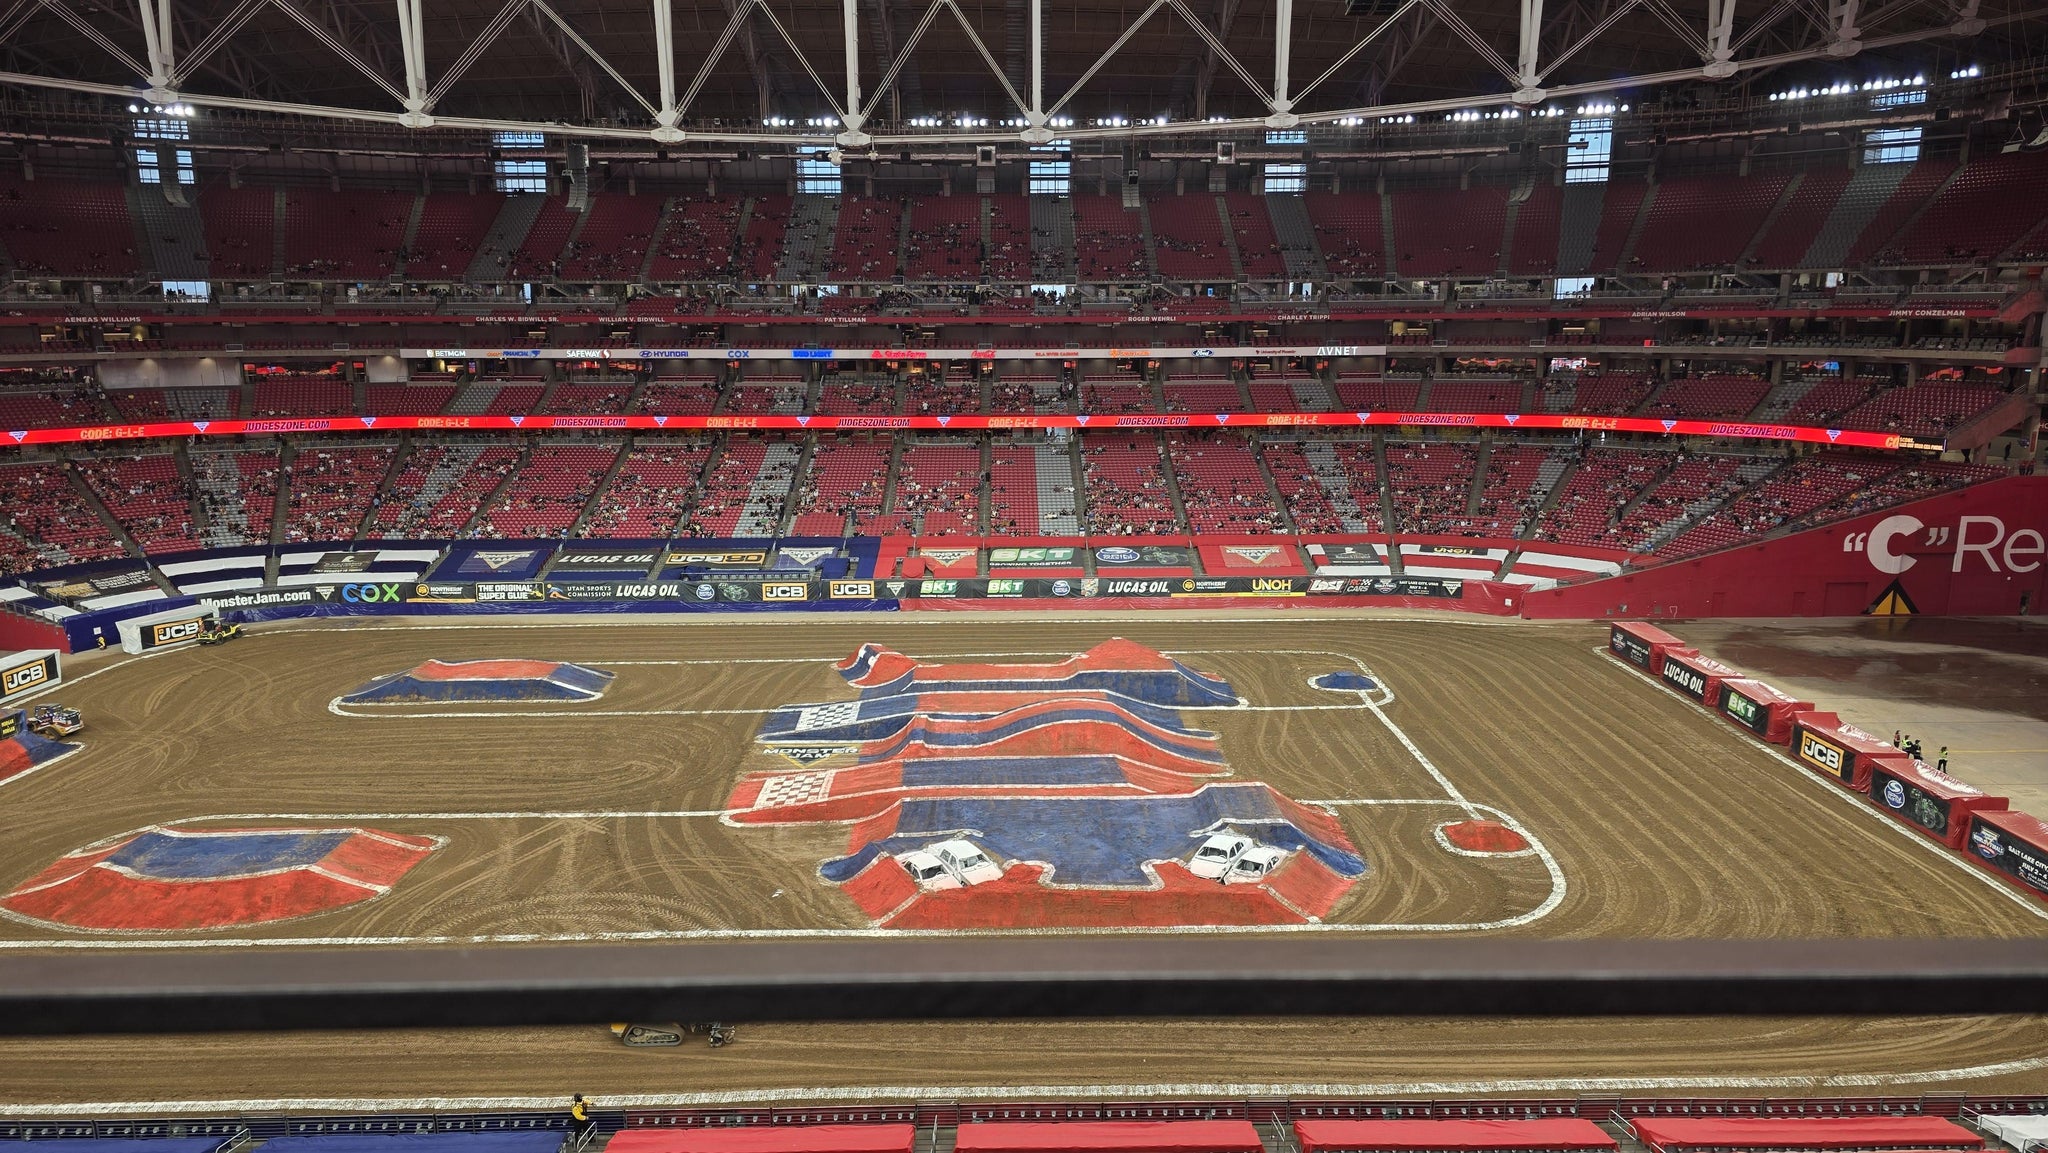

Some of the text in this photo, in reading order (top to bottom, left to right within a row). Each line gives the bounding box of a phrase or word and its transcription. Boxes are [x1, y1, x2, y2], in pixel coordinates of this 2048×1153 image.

[566, 350, 600, 358] SAFEWAY
[653, 350, 689, 358] HYUNDAI
[727, 350, 750, 358] COX
[1316, 346, 1358, 356] AVNET
[418, 418, 470, 427] CODE: G-L-E
[551, 418, 626, 427] JUDGESZONE.COM
[706, 418, 757, 427] CODE: G-L-E
[836, 418, 910, 427] JUDGESZONE.COM
[988, 418, 1038, 427] CODE: G-L-E
[1115, 417, 1189, 426] JUDGESZONE.COM
[1266, 416, 1318, 425] CODE: G-L-E
[1396, 415, 1475, 424] JUDGESZONE.COM
[1562, 418, 1618, 429] CODE: G-L-E
[242, 420, 329, 432] JUDGESZONE.COM
[1706, 424, 1796, 438] JUDGESZONE.COM
[80, 427, 144, 440] CODE: G-L-E
[558, 555, 623, 563] LUCAS
[992, 548, 1073, 561] BKT
[478, 584, 532, 592] THE ORIGINAL
[834, 584, 871, 595] JCB
[920, 580, 957, 594] BKT
[987, 580, 1024, 594] BKT
[1107, 581, 1148, 593] LUCAS
[1252, 579, 1293, 590] UNOH
[342, 583, 401, 603] COX
[478, 592, 529, 600] SUPER GLUE
[616, 584, 657, 597] LUCAS
[766, 586, 804, 598] JCB
[200, 591, 311, 608] MonsterJam.com
[158, 622, 199, 641] JCB
[7, 665, 43, 689] JCB
[1663, 662, 1690, 687] LUCAS
[1728, 692, 1756, 721] BKT
[763, 746, 858, 754] MONSTER
[1804, 740, 1841, 770] JCB
[2008, 845, 2021, 857] SALT
[2021, 852, 2035, 865] LAKE
[2022, 861, 2034, 873] JULY
